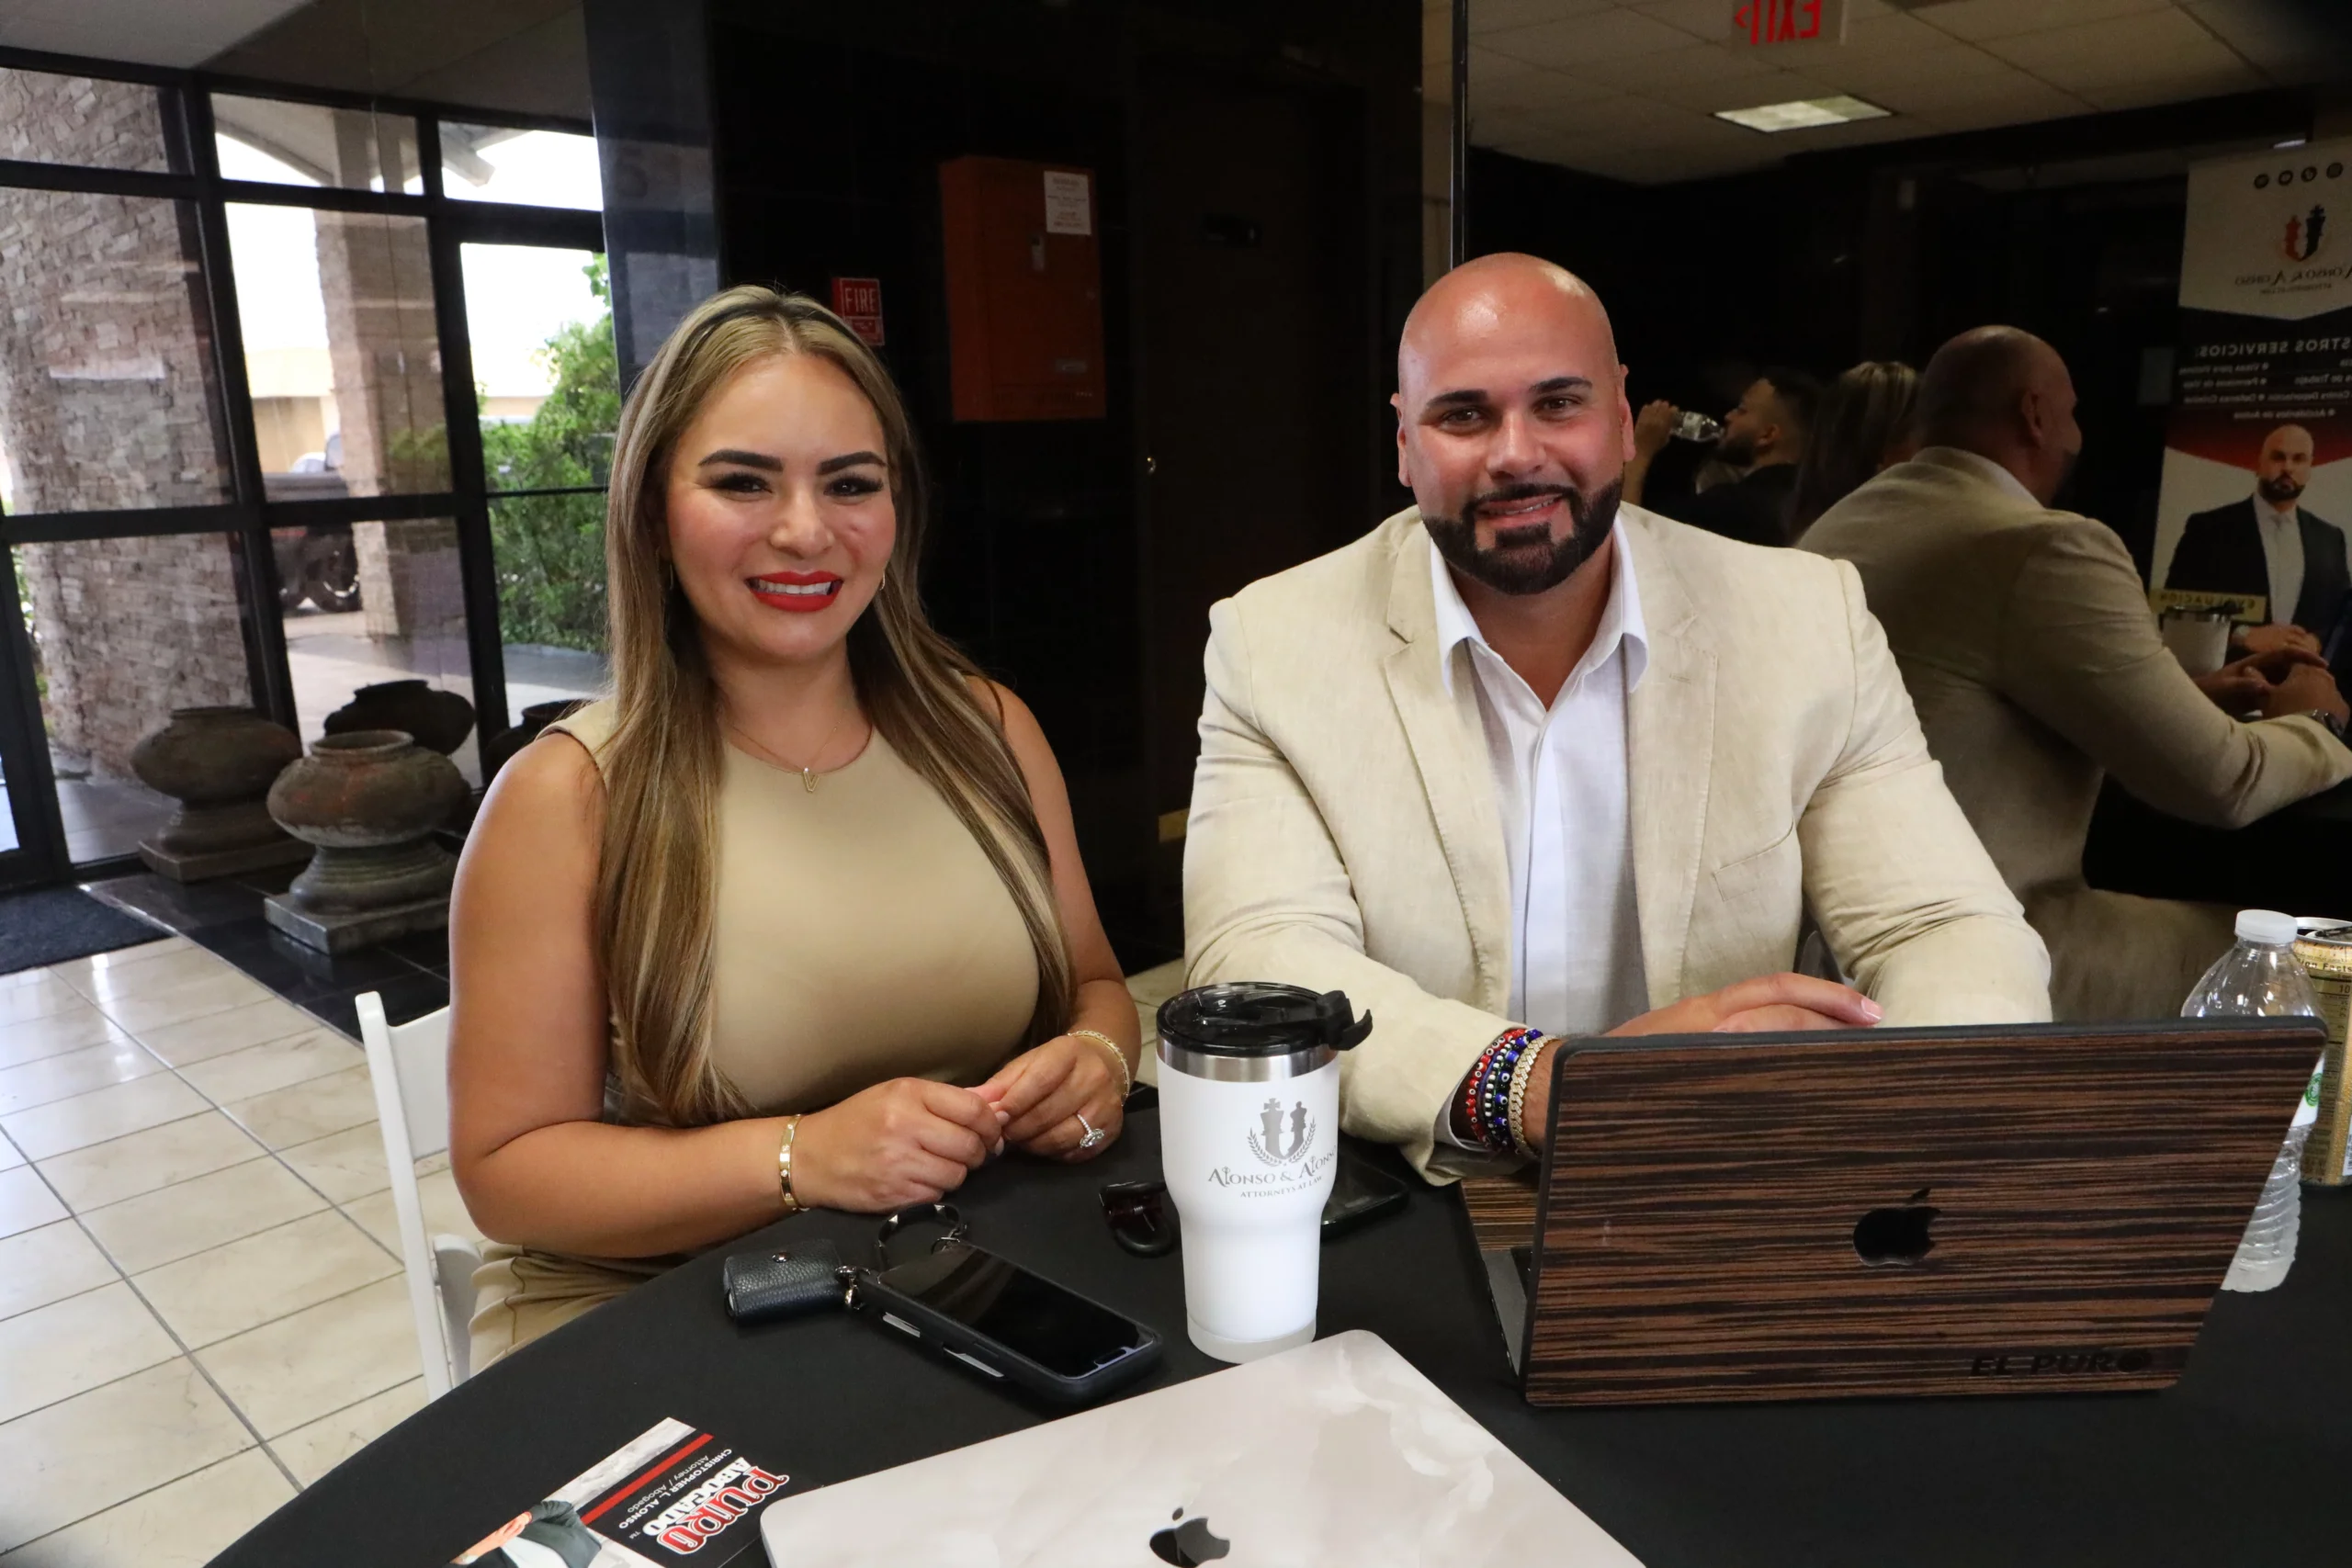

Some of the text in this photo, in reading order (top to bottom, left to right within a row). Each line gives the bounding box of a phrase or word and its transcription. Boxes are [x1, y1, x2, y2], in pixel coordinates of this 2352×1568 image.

[844, 287, 876, 312] FIRE
[1208, 1166, 1276, 1188] ALONSO
[1280, 1170, 1295, 1181] &
[1240, 1175, 1323, 1198] ATTORNEYS AT LAW
[673, 1454, 709, 1482] Attorney
[618, 1448, 732, 1530] CHRISTOPHER L. ALONSO
[627, 1483, 667, 1514] Abogado
[642, 1456, 752, 1537] ABOGADO
[656, 1465, 790, 1555] PURO
